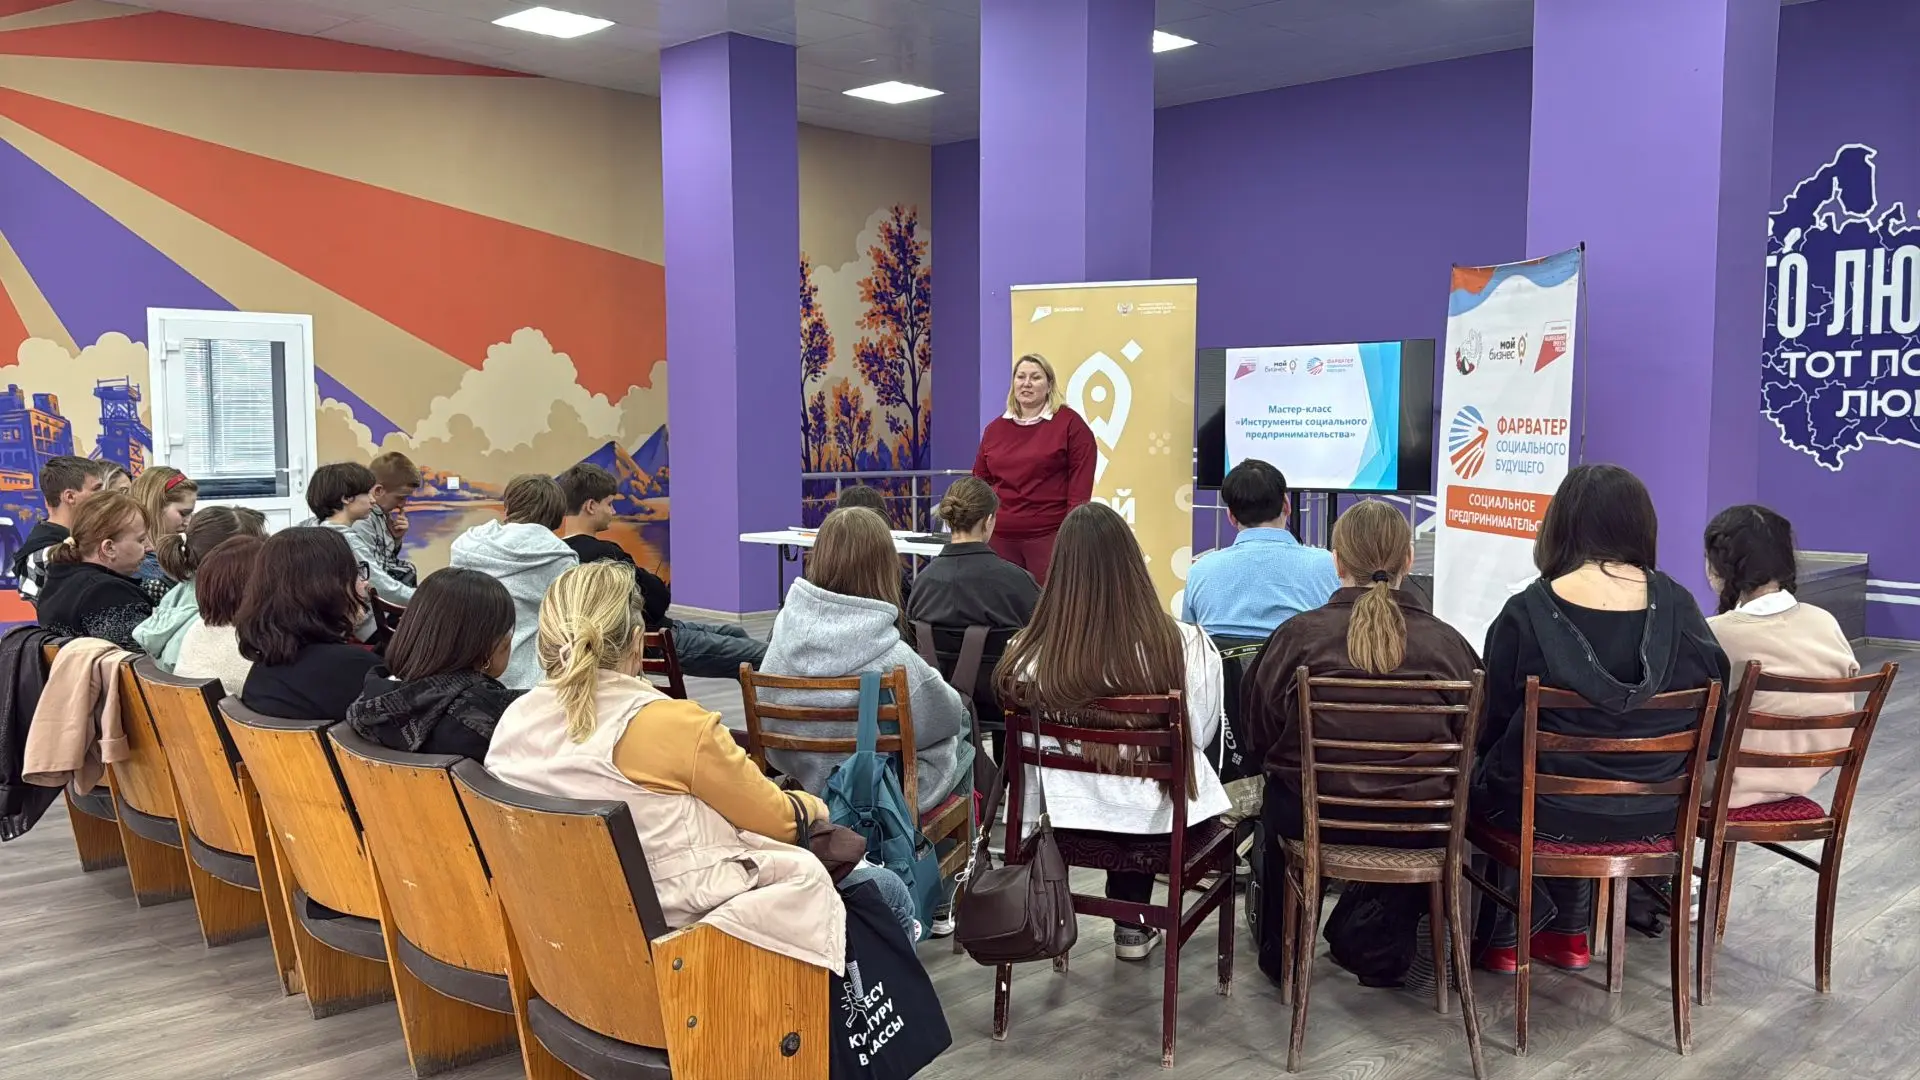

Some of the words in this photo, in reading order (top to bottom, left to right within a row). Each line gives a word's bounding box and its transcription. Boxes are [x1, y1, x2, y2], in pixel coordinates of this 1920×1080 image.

[1827, 244, 1920, 336] ЛЮ
[1489, 348, 1515, 360] бизнес
[1781, 351, 1862, 378] ТОТ
[1871, 350, 1920, 377] ПО
[1268, 405, 1332, 415] Мастер-класс
[1836, 389, 1920, 418] ЛЮ
[1235, 418, 1303, 428] «Инструменты
[1305, 418, 1368, 428] социального
[1497, 416, 1567, 435] ФАРВАТЕР
[1245, 430, 1356, 440] предпринимательства»
[1496, 440, 1567, 456] СОЦИАЛЬНОГО
[1495, 459, 1544, 475] БУДУЩЕГО
[1468, 493, 1536, 513] СОЦИАЛЬНОЕ
[1448, 508, 1543, 533] ПРЕДПРИНИМАТЕЛЬС
[863, 981, 884, 1009] ЕСУ
[858, 1053, 870, 1067] В
[869, 1015, 905, 1056] АССЫ
